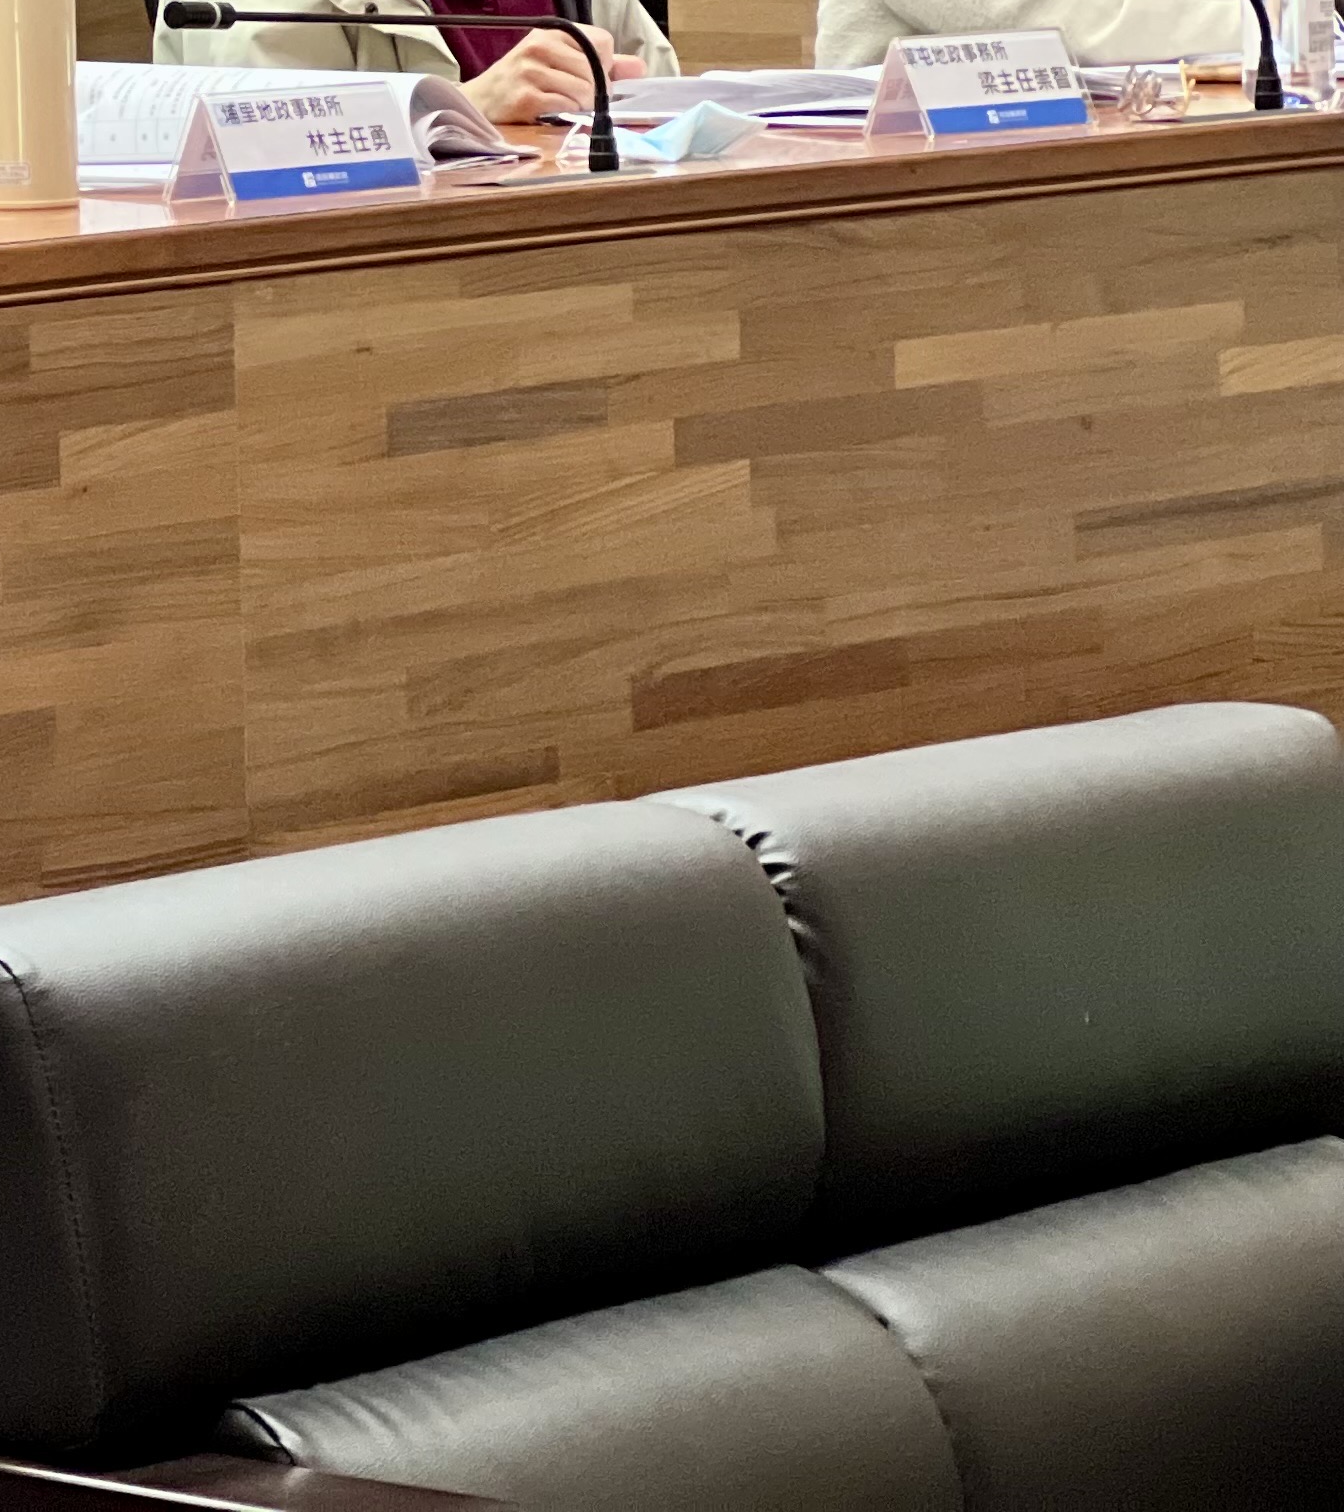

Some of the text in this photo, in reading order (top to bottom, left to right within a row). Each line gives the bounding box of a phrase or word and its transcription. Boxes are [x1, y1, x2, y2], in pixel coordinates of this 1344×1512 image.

[220, 94, 344, 125] 埔里地政事務所
[306, 124, 392, 157] 林主任勇
